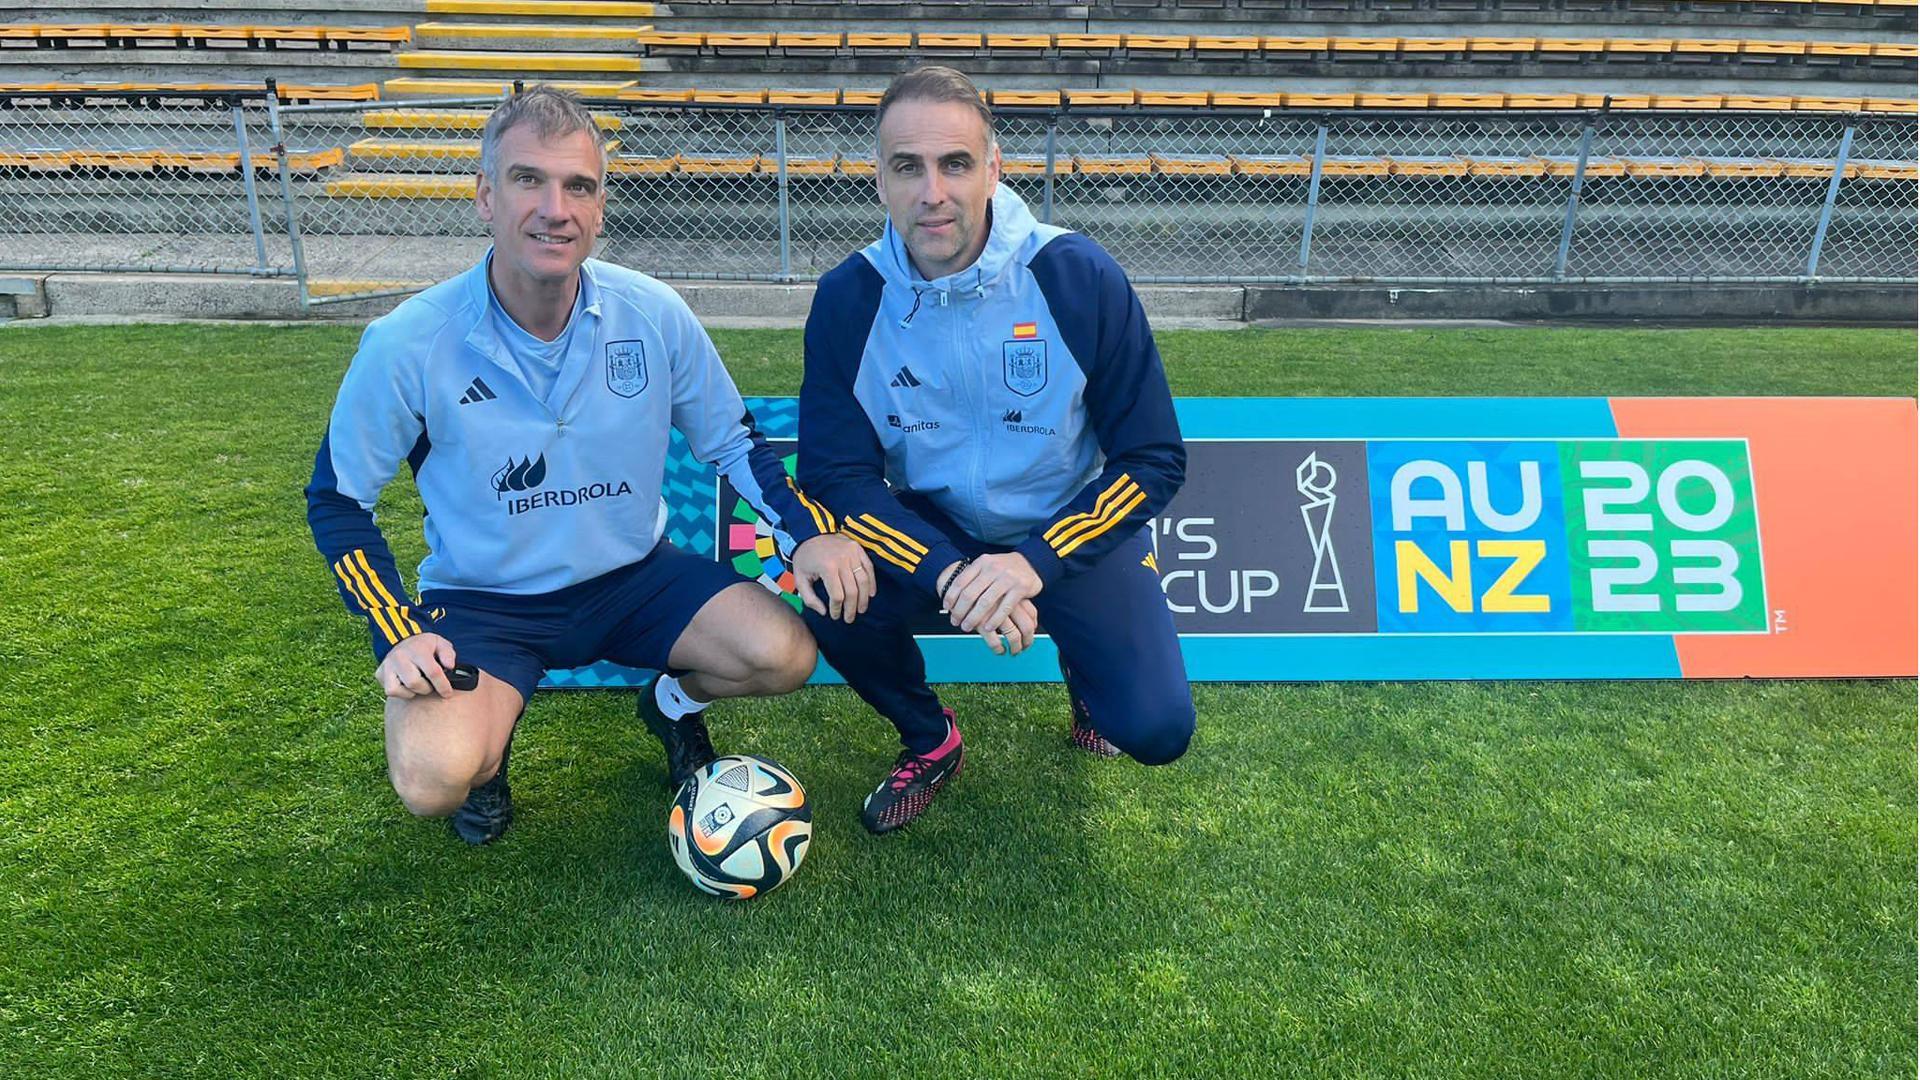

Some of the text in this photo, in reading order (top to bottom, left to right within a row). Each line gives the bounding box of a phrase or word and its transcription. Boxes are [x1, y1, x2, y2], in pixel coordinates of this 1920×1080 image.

[901, 420, 940, 433] anitas
[1006, 425, 1056, 436] IBERDROLA
[509, 481, 632, 515] IBERDROLA
[1390, 460, 1543, 533] AU
[1579, 460, 1735, 532] 20
[1160, 569, 1280, 613] CUP
[1395, 540, 1551, 613] NZ
[1587, 540, 1744, 612] 23
